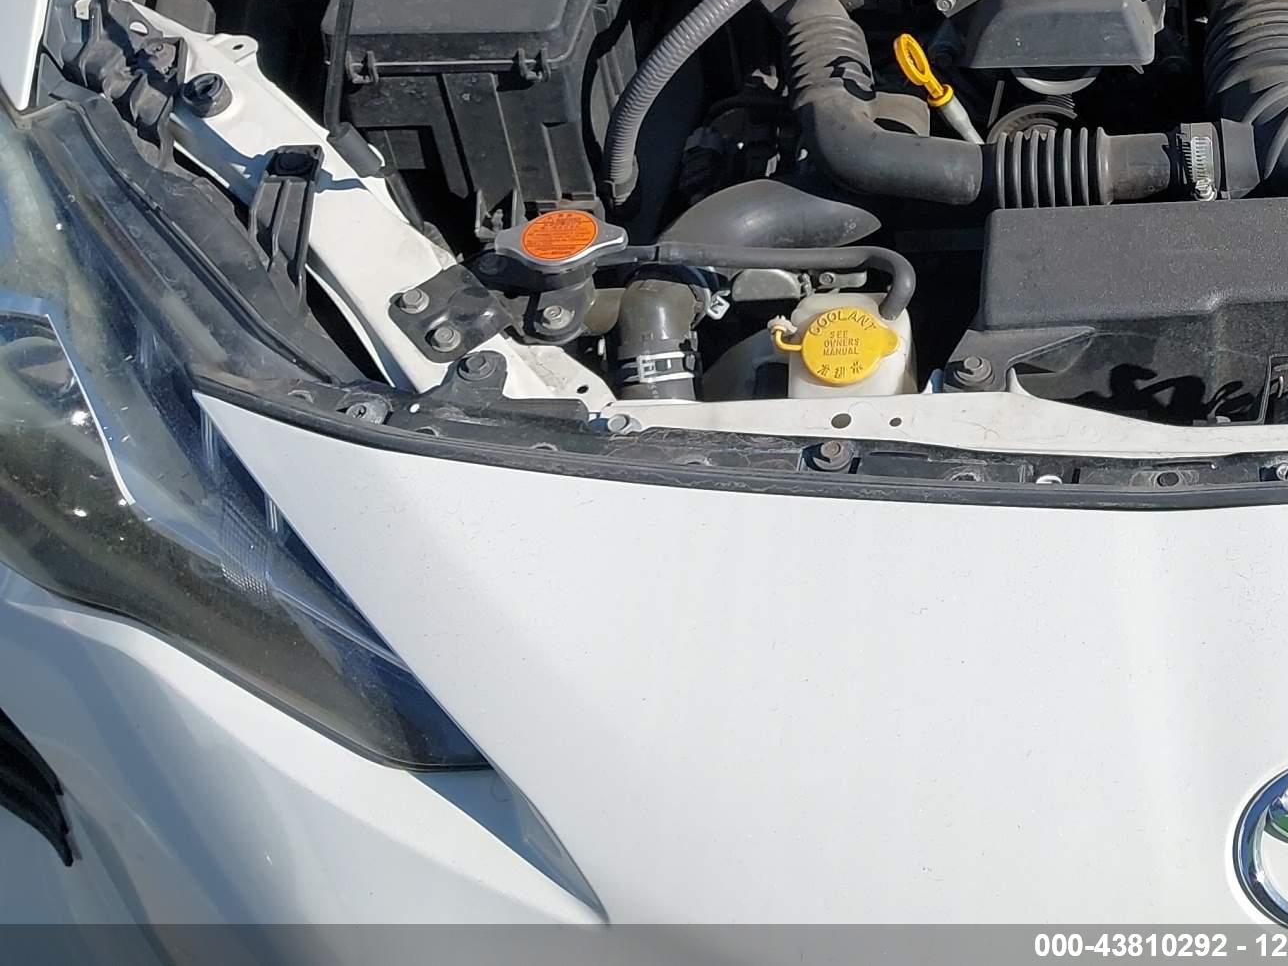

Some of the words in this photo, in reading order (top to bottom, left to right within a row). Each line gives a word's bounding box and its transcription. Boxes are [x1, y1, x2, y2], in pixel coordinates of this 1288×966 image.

[808, 310, 878, 336] COOLANT
[829, 330, 849, 339] SEE
[823, 338, 861, 347] OWNERS
[823, 347, 860, 356] MANUAL
